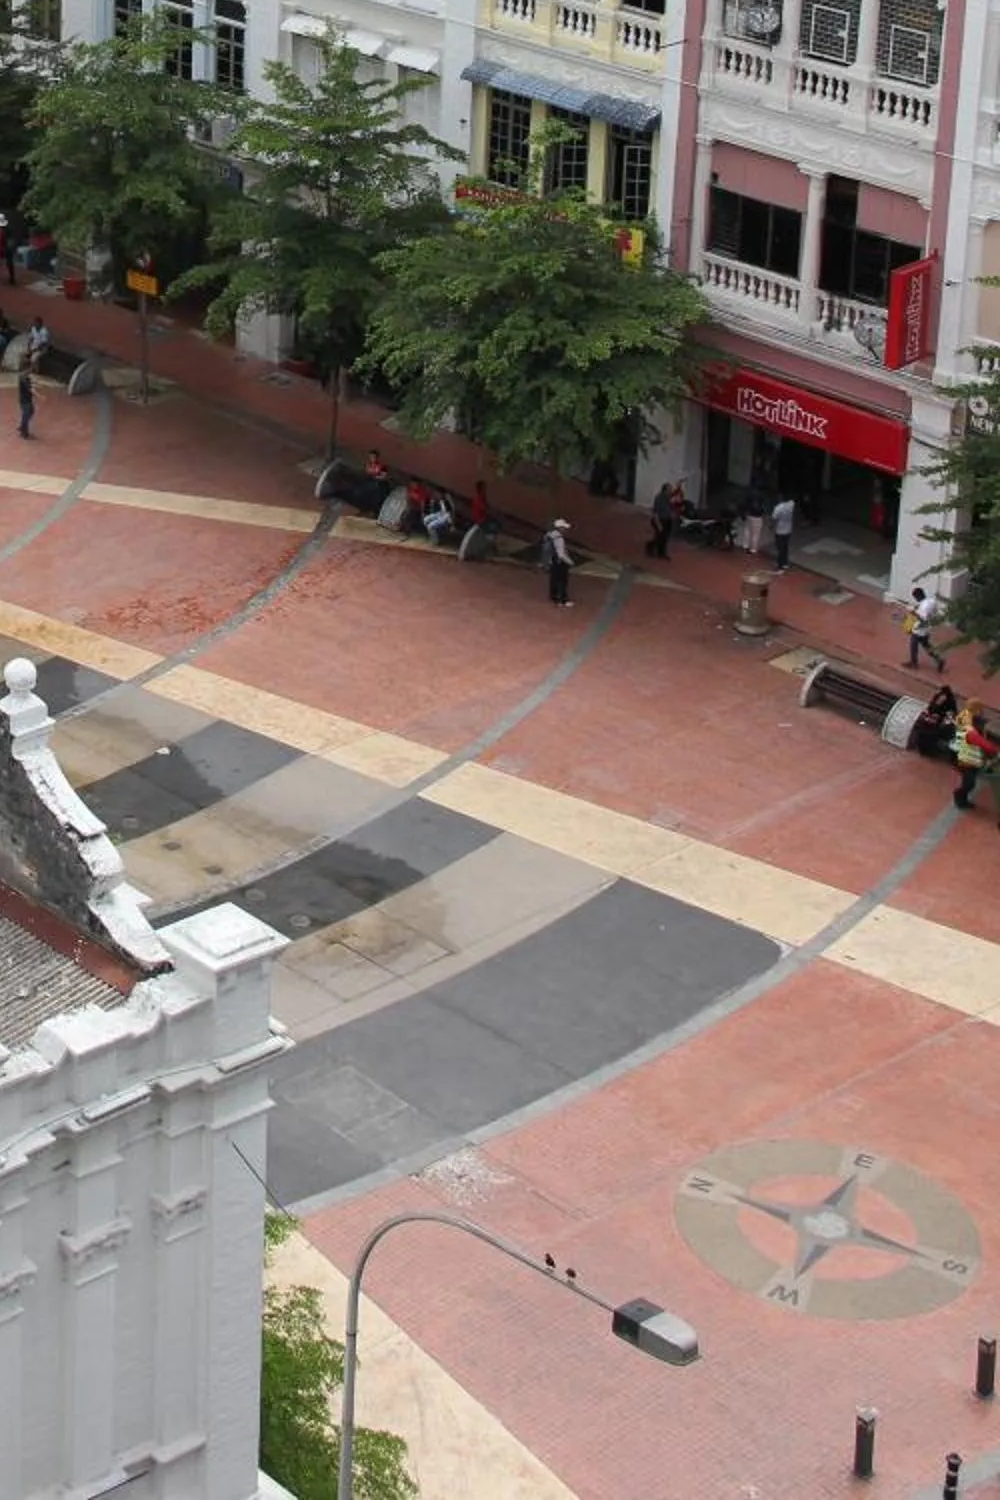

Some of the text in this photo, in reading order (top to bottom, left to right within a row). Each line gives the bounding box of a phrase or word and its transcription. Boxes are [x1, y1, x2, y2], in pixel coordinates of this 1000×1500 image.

[853, 1152, 876, 1169] E
[688, 1175, 715, 1193] N
[941, 1258, 969, 1276] S
[767, 1283, 800, 1305] W
